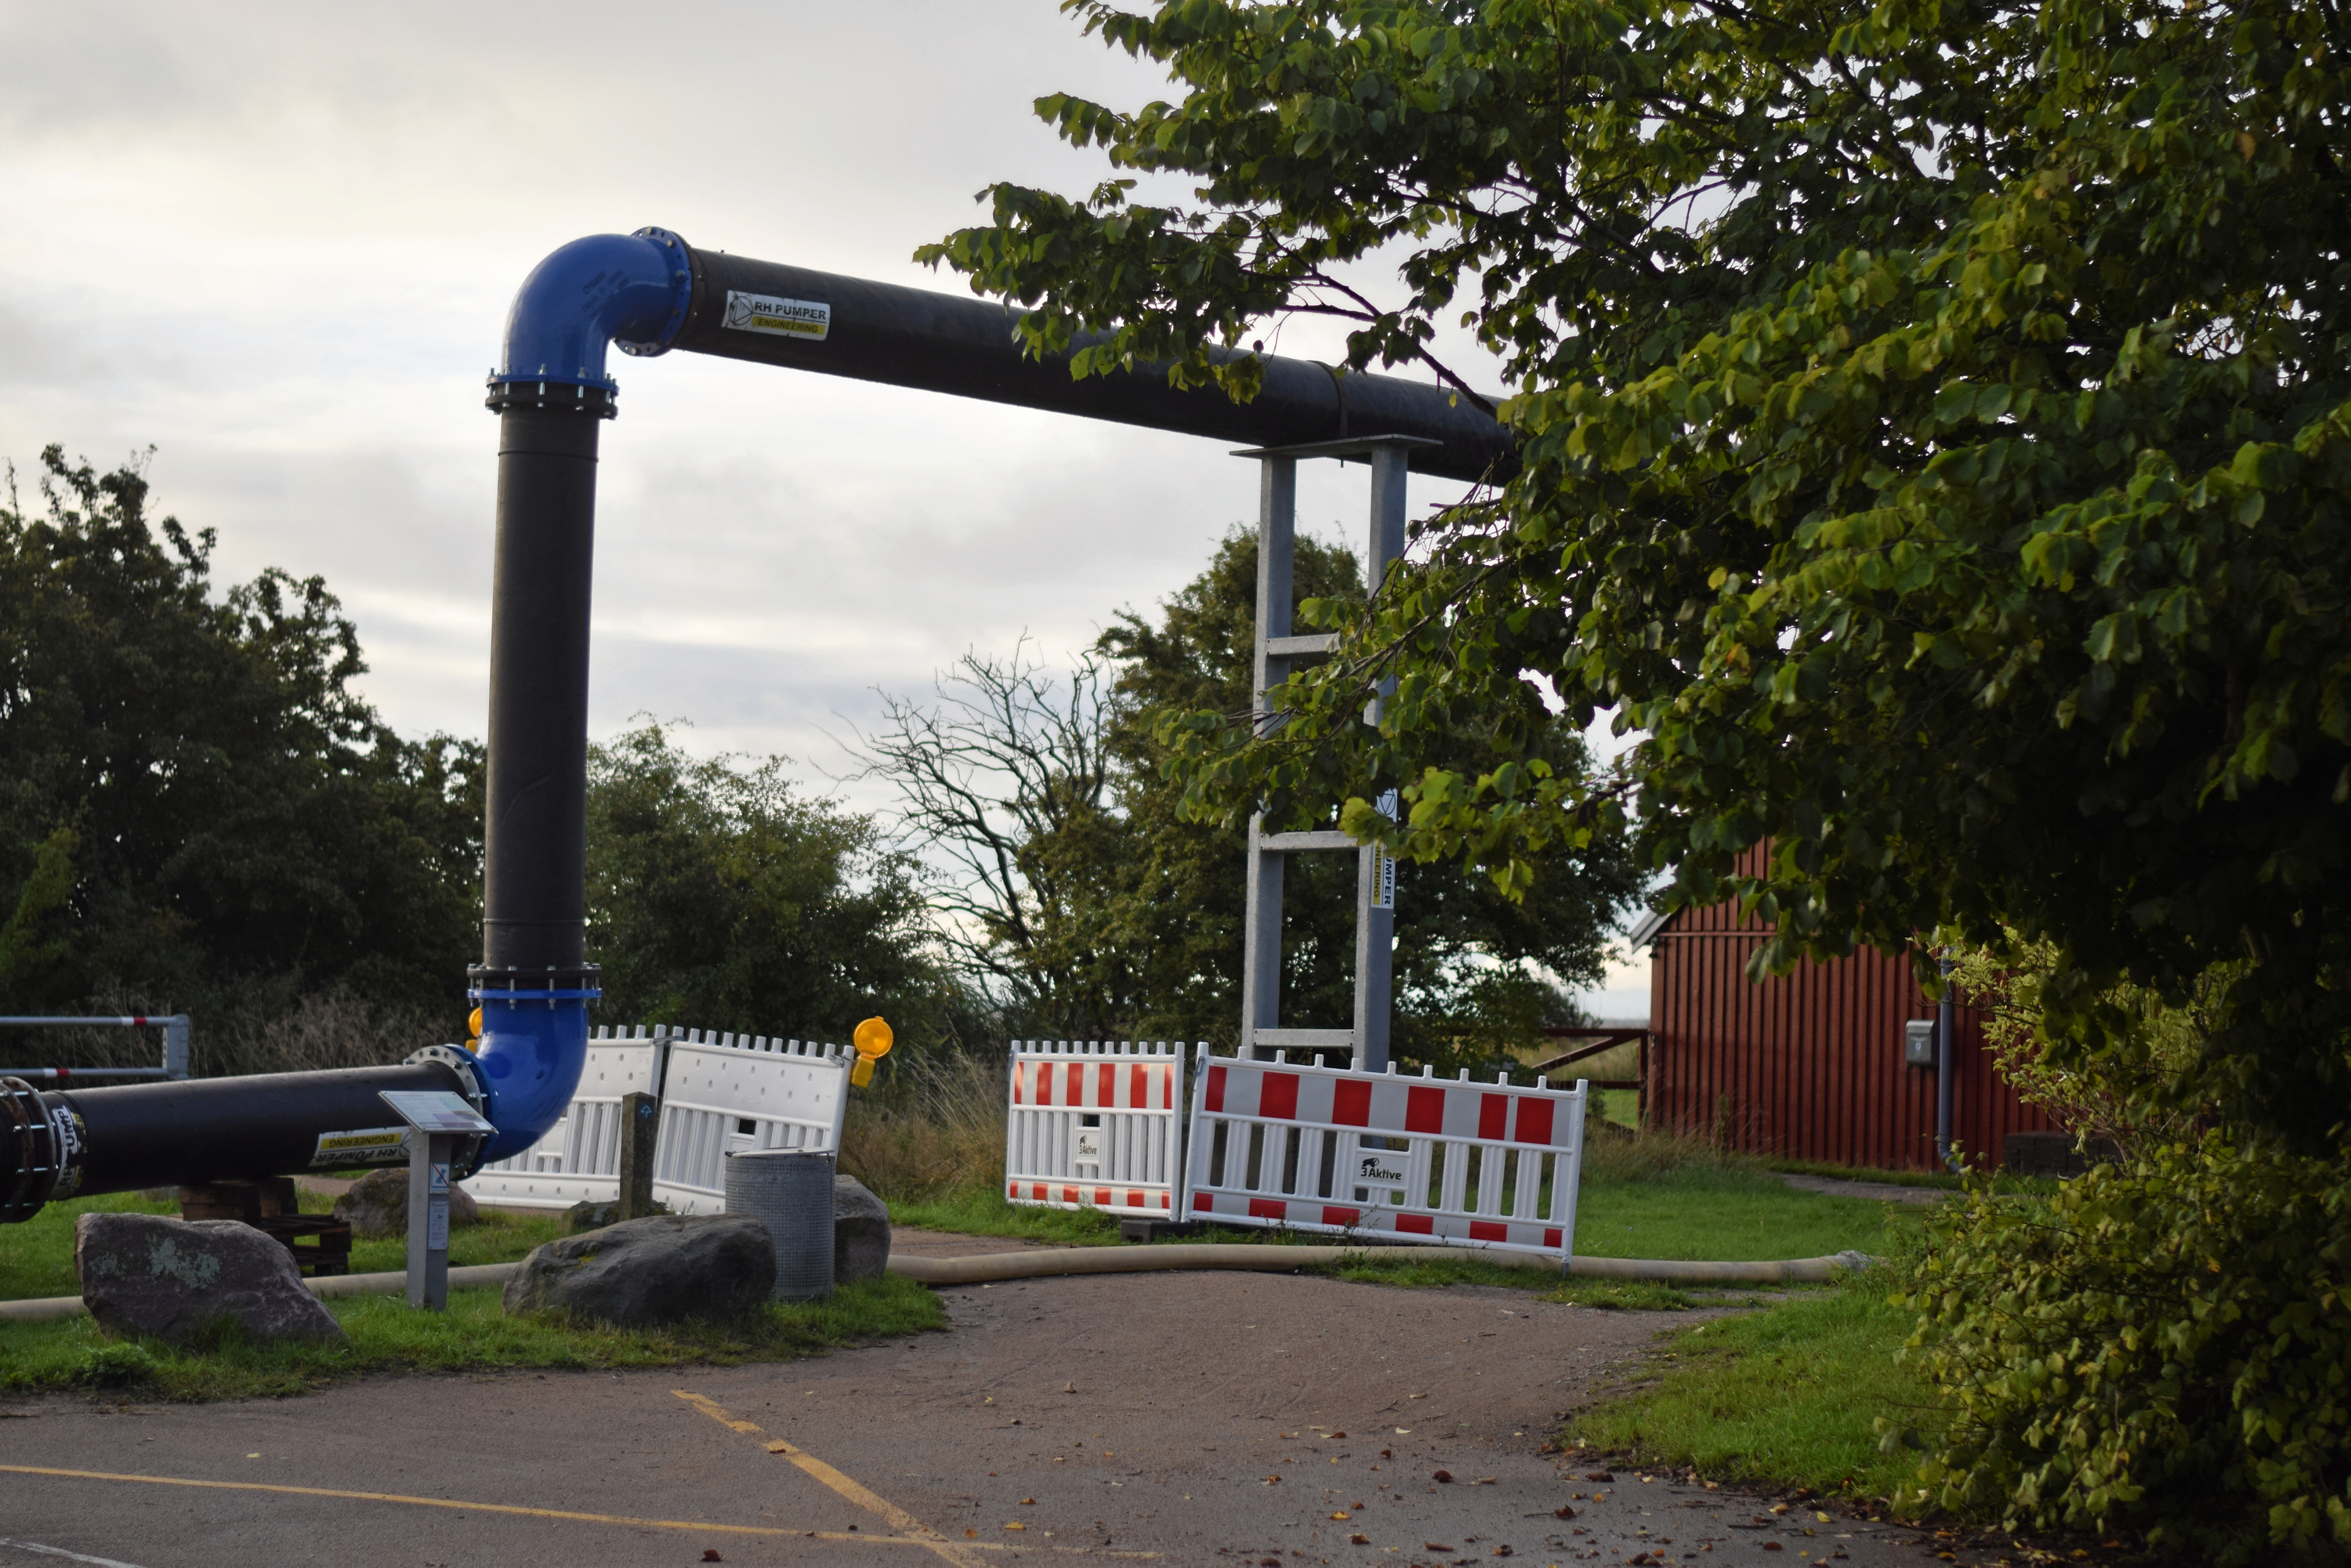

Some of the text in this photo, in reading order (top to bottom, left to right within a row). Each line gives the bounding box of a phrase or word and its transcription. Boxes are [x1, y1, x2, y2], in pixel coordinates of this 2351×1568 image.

[755, 302, 827, 320] RH PUMPER
[758, 317, 818, 333] ENGINEERING
[329, 1135, 395, 1148] ENGINEERING
[377, 1148, 397, 1157] RH
